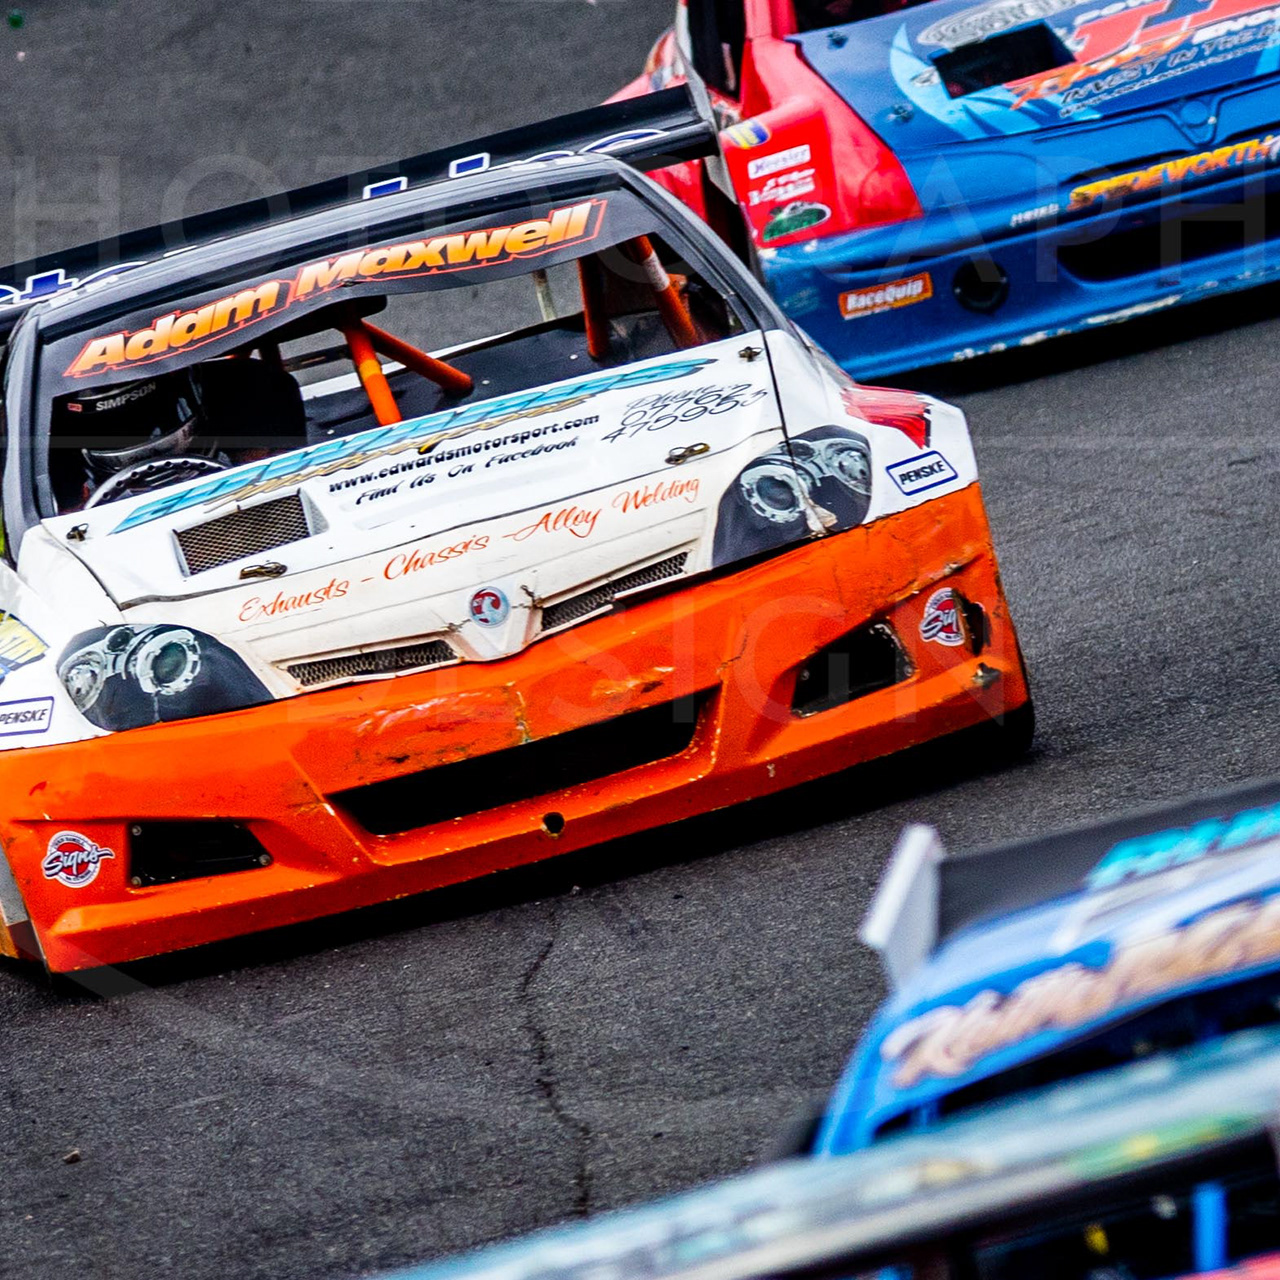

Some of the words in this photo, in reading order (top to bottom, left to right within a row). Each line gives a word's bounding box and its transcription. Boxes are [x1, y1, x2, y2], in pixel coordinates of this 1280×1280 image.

[64, 276, 288, 378] Adam
[289, 199, 604, 304] Maxwell
[95, 381, 158, 413] SIMPSON
[328, 412, 601, 494] www.edwardsmotorsport.com
[484, 434, 580, 469] Facebook
[897, 457, 949, 487] PENSKE
[236, 576, 351, 623] Exhausts
[384, 535, 491, 583] Chassis
[510, 502, 603, 543] Alloy
[613, 473, 702, 518] Welding
[43, 844, 114, 878] Signs
